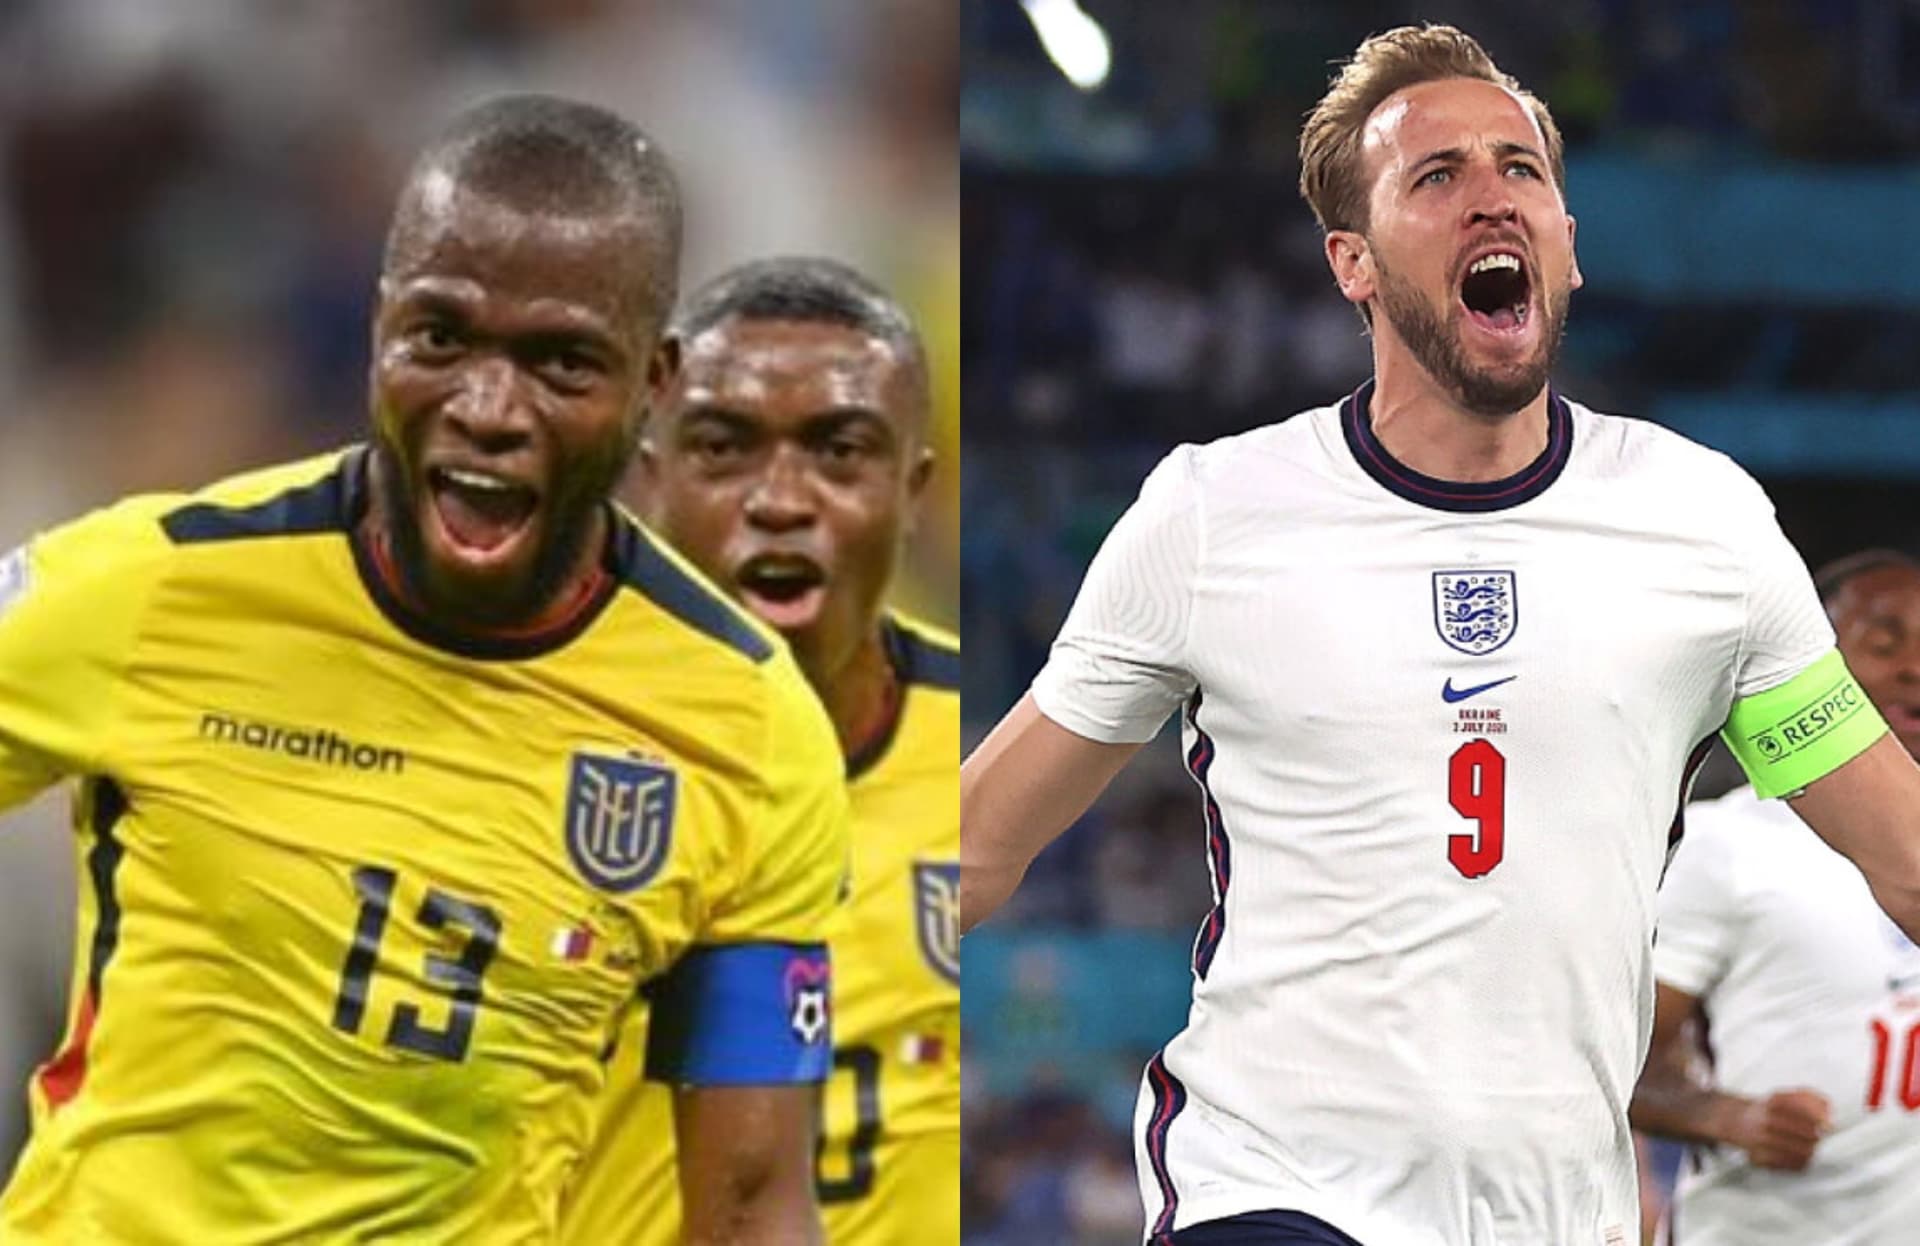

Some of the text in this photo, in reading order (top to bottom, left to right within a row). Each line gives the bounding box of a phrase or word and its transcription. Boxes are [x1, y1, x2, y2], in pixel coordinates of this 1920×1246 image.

[202, 713, 405, 774] marathon
[1782, 683, 1860, 746] RESPEC
[1448, 738, 1506, 879] 9
[332, 864, 503, 1064] 13
